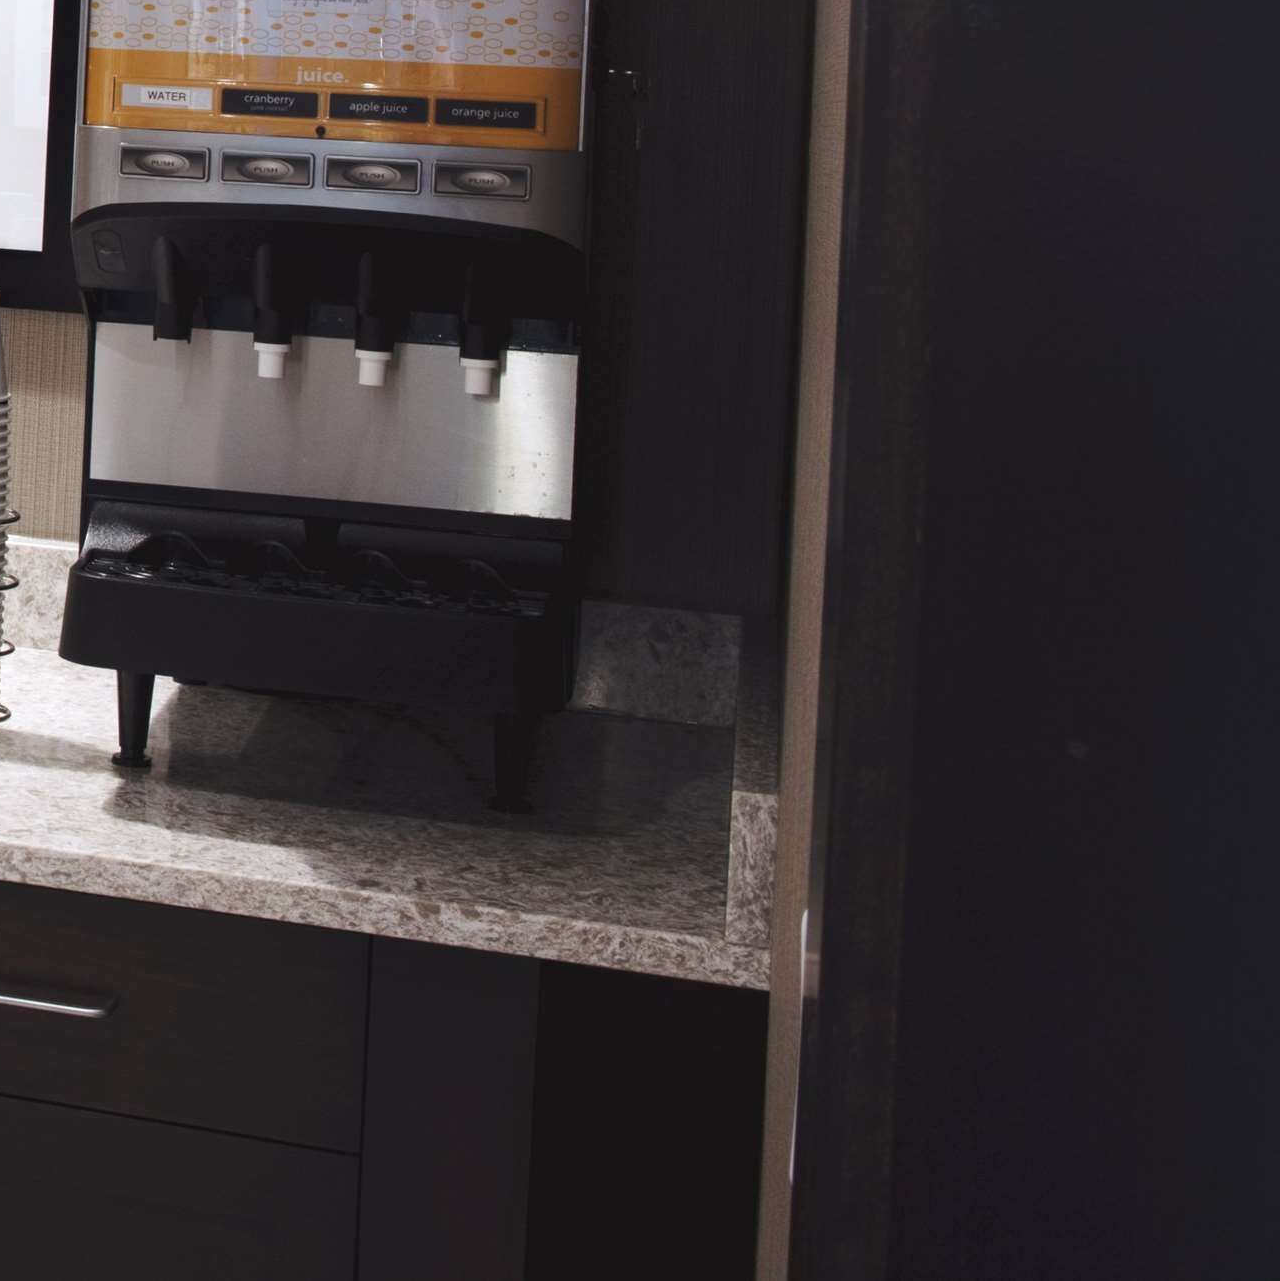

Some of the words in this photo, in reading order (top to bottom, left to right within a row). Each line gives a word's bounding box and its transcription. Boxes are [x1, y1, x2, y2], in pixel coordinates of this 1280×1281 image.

[296, 66, 349, 85] juice.
[147, 90, 187, 102] WATER
[243, 93, 295, 107] cranberry
[349, 102, 379, 113] apple
[381, 104, 408, 115] juice
[451, 107, 491, 120] orange
[492, 109, 520, 120] juice
